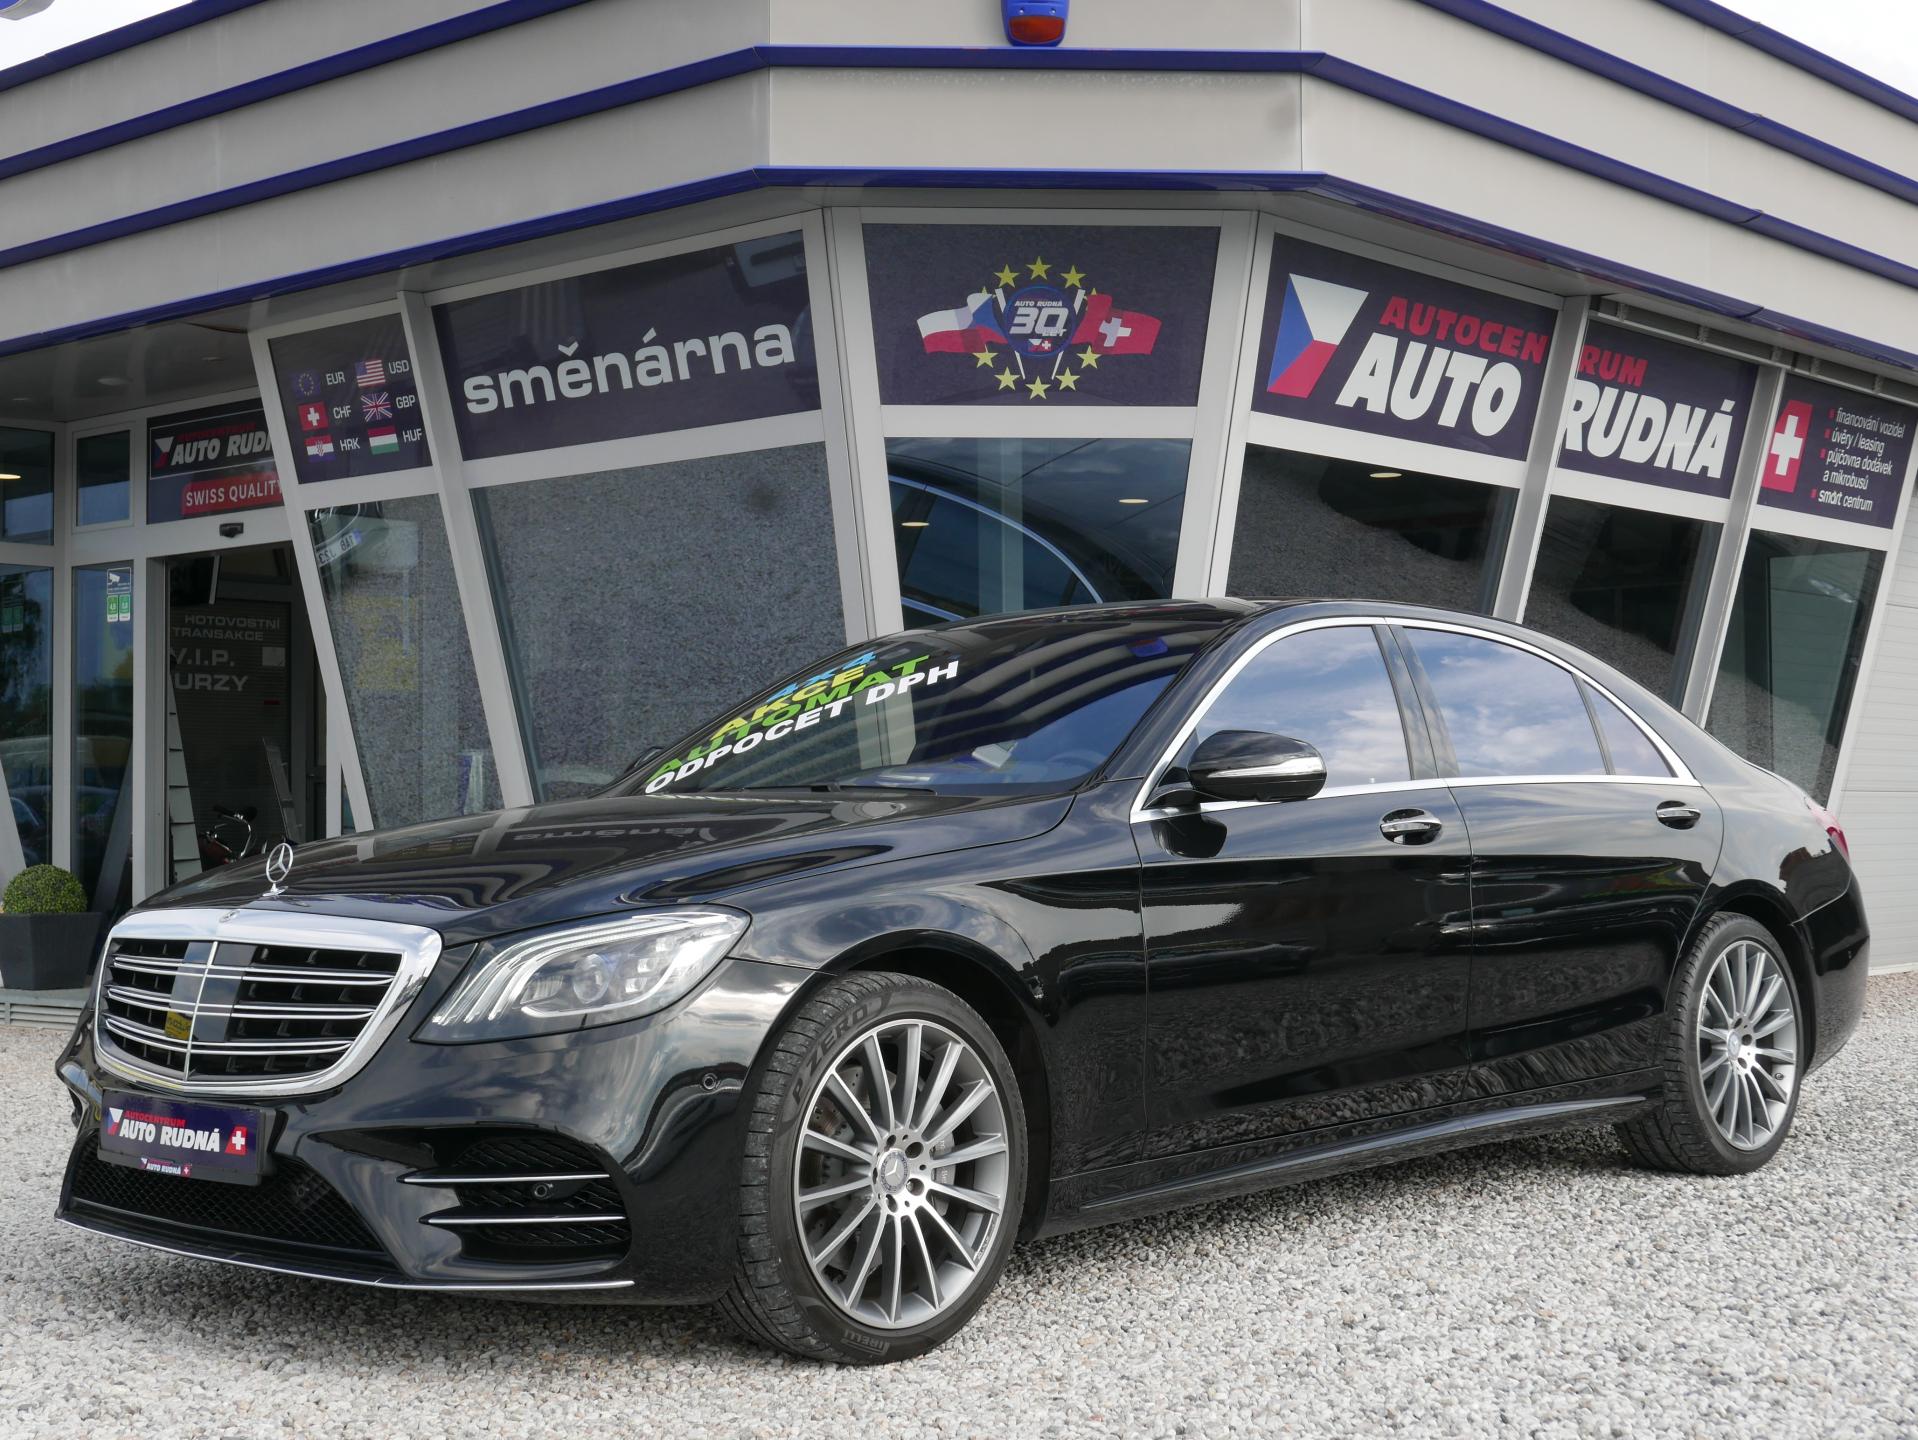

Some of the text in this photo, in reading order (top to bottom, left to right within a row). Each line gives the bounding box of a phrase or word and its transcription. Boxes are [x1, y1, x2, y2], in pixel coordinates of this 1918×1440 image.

[1009, 307, 1069, 334] 30
[325, 371, 346, 385] EUR
[388, 360, 410, 374] USD
[463, 324, 796, 414] směnárna
[333, 405, 352, 419] CHF
[395, 394, 416, 409] GBP
[1335, 332, 1736, 479] AUTO RUDNÁ
[1836, 408, 1906, 438] financování vozidel
[339, 437, 361, 451] HRK
[402, 428, 423, 442] HUF
[1831, 427, 1853, 449] úvěry
[1858, 433, 1885, 457] leasing
[170, 438, 220, 466] AUTO
[1826, 447, 1893, 475] půjčovna dodávek
[1823, 470, 1830, 482] a
[186, 488, 225, 507] SWISS
[1843, 495, 1873, 512] centrum
[174, 672, 248, 692] URZY
[709, 665, 866, 741] AKCE
[645, 655, 930, 784] AUTOMAT
[645, 661, 959, 794] ODPOCET DPH
[806, 1003, 868, 1077] ZERO
[124, 1110, 186, 1127] AUTOCENTRUM
[119, 1119, 219, 1152] AUTO RUDNÁ
[146, 1163, 160, 1172] AUTO
